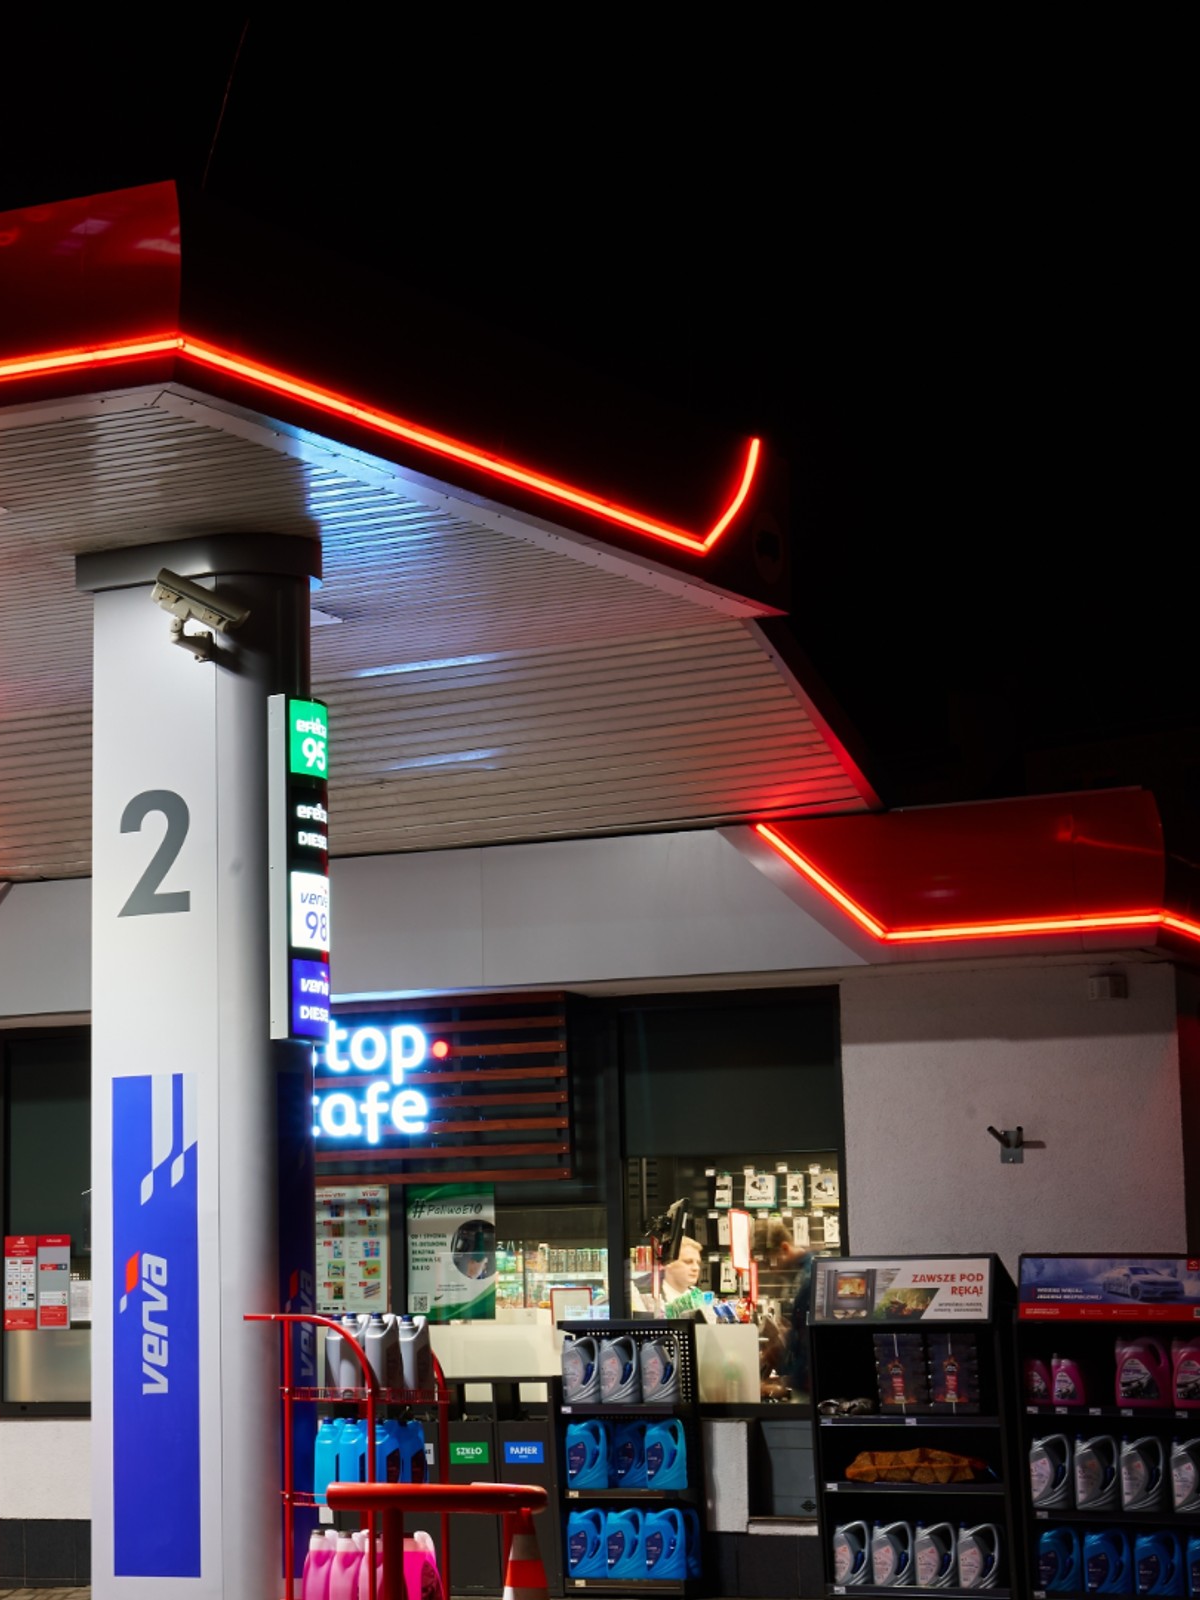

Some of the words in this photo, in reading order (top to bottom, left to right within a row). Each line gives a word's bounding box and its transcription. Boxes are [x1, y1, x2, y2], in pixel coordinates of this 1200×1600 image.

[302, 737, 326, 772] 95
[116, 789, 190, 917] 2
[298, 831, 328, 850] DIES
[305, 911, 328, 942] 98
[300, 977, 329, 996] verv
[300, 1005, 329, 1023] DIES
[312, 1020, 427, 1085] top
[311, 1081, 429, 1144] afe
[911, 1273, 956, 1283] ZAWSZE
[960, 1273, 984, 1282] POD
[142, 1253, 168, 1395] verva
[510, 1446, 538, 1455] PAPIER
